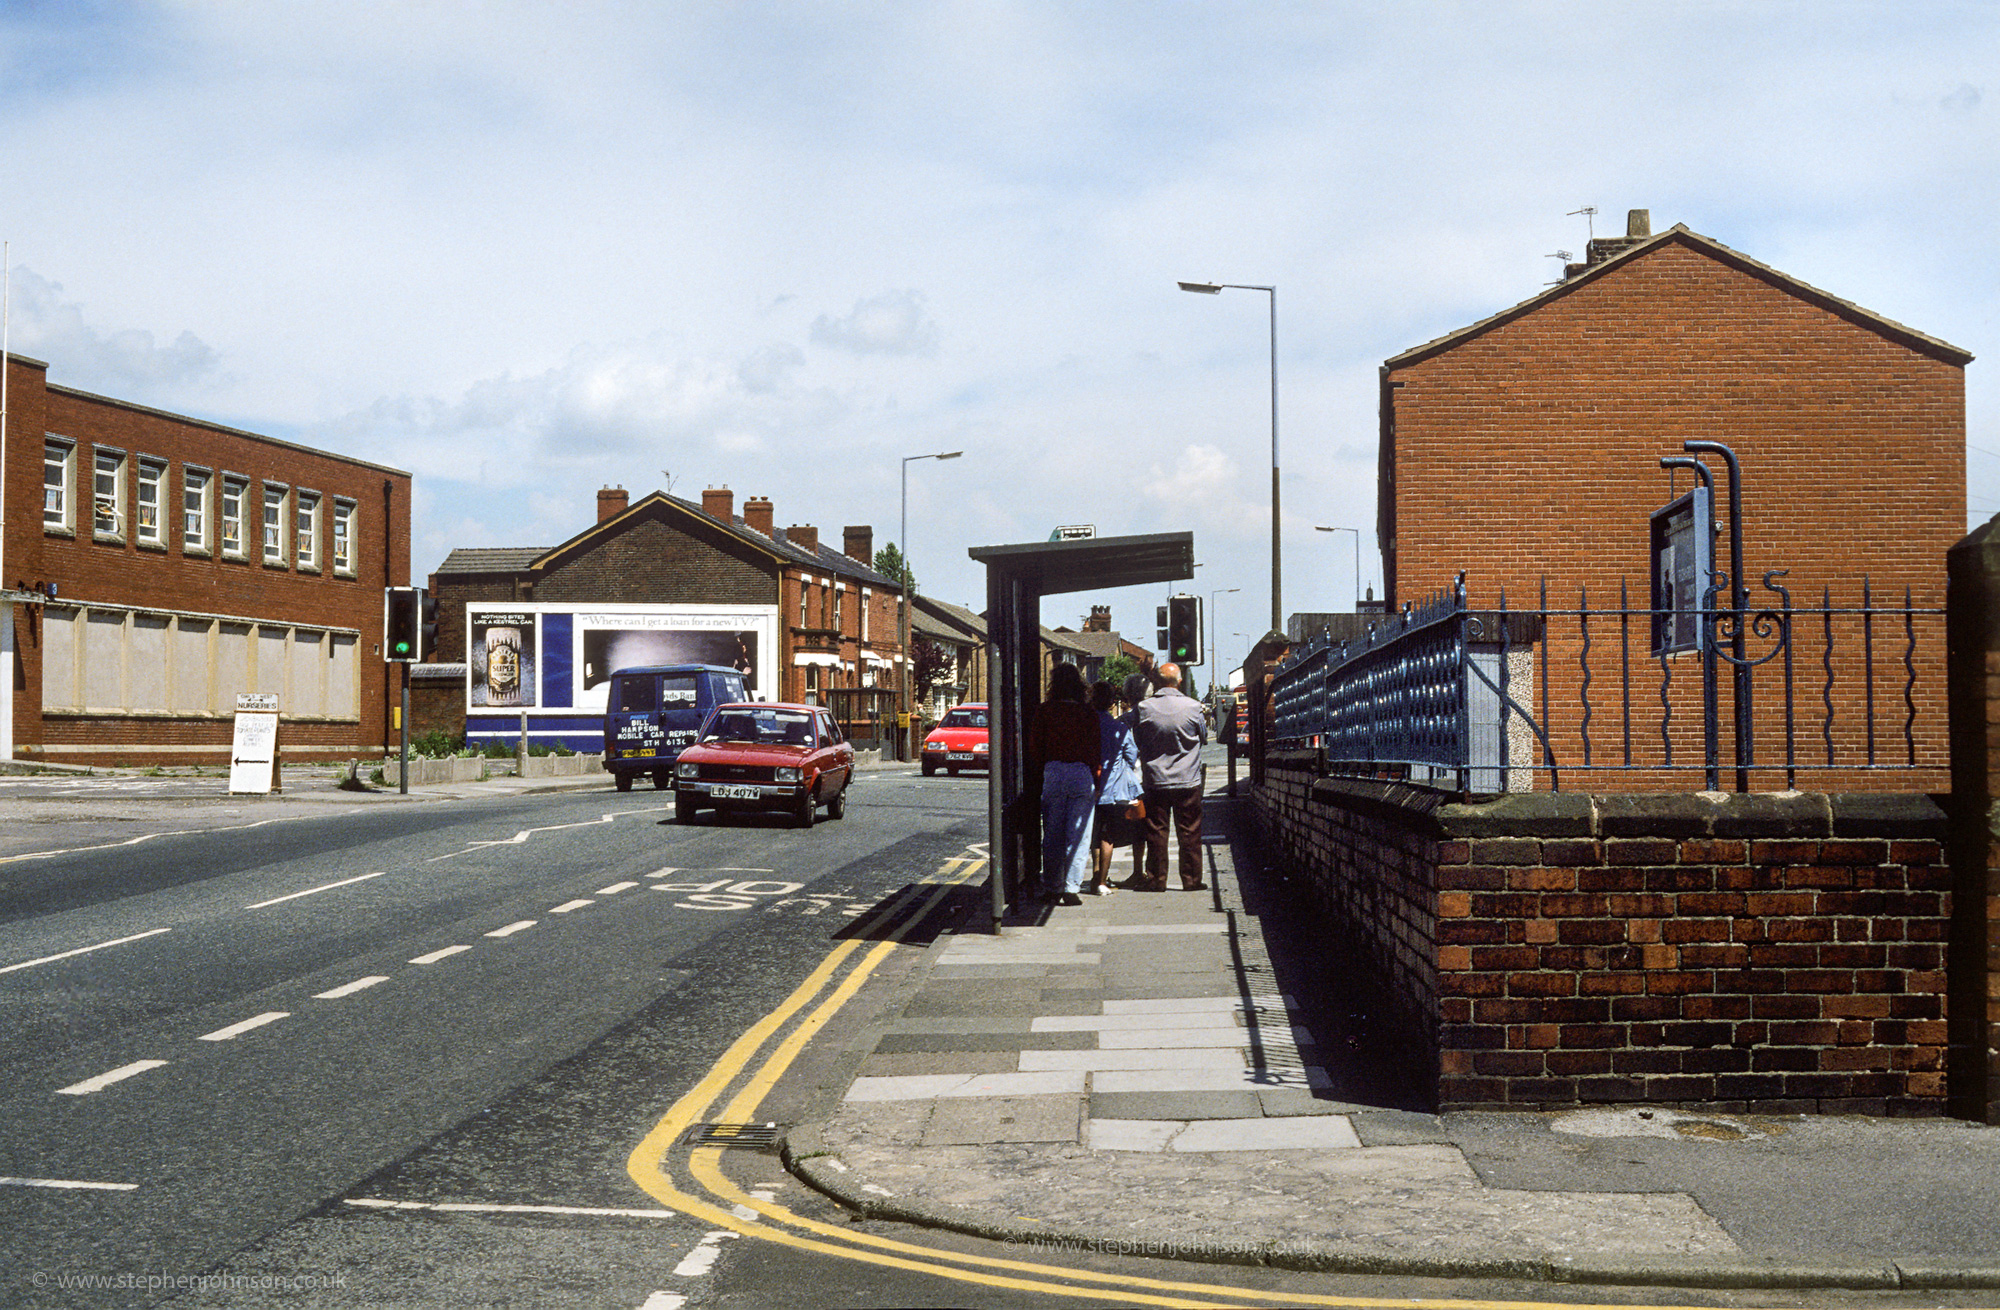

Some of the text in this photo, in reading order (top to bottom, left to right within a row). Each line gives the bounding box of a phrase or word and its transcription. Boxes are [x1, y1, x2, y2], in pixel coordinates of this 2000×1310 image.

[624, 618, 641, 626] can
[647, 618, 661, 628] get
[670, 616, 690, 626] loan
[691, 616, 705, 626] for
[712, 618, 732, 626] new
[631, 719, 650, 727] BILL
[617, 729, 699, 740] MOBILE CAR REPAIRS
[621, 725, 659, 734] HAMPSON
